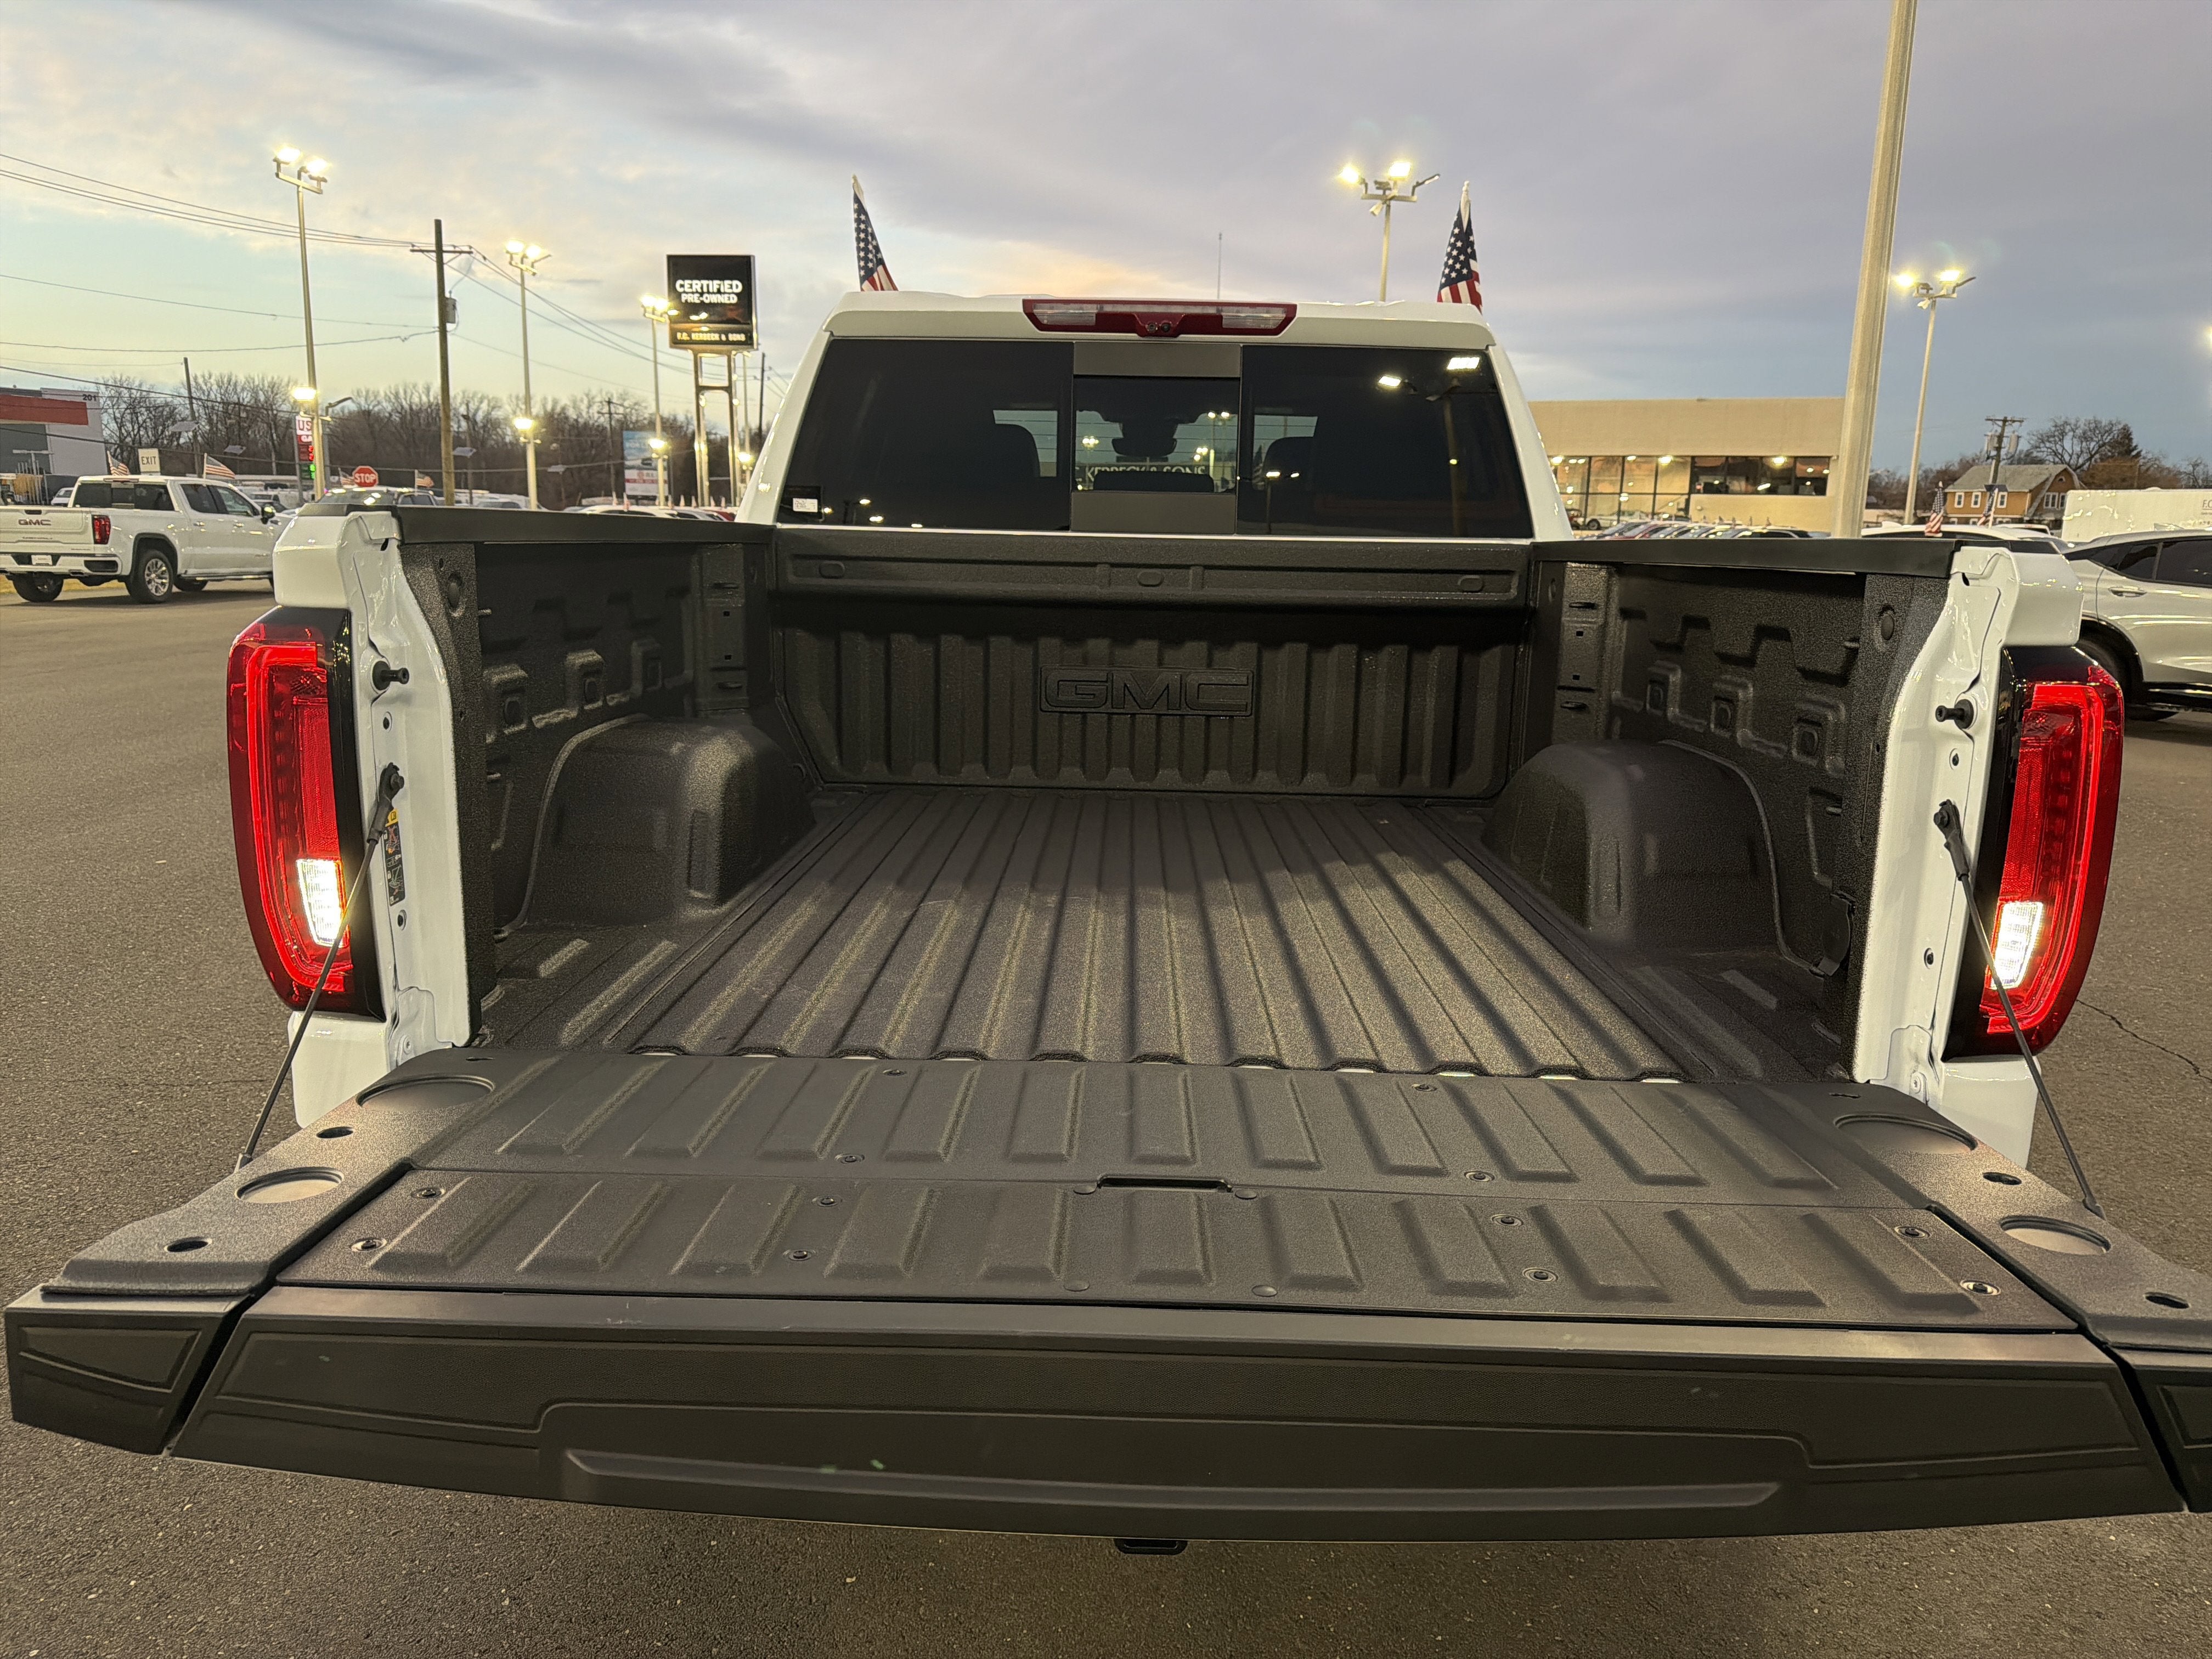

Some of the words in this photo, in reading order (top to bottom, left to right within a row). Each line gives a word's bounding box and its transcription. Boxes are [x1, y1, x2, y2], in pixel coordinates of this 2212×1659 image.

[675, 279, 743, 293] CERTIFIED
[681, 293, 738, 303] PRE-OWNED
[141, 456, 156, 465] EXIT
[354, 473, 376, 483] STOP
[1045, 671, 1249, 712] GMC
